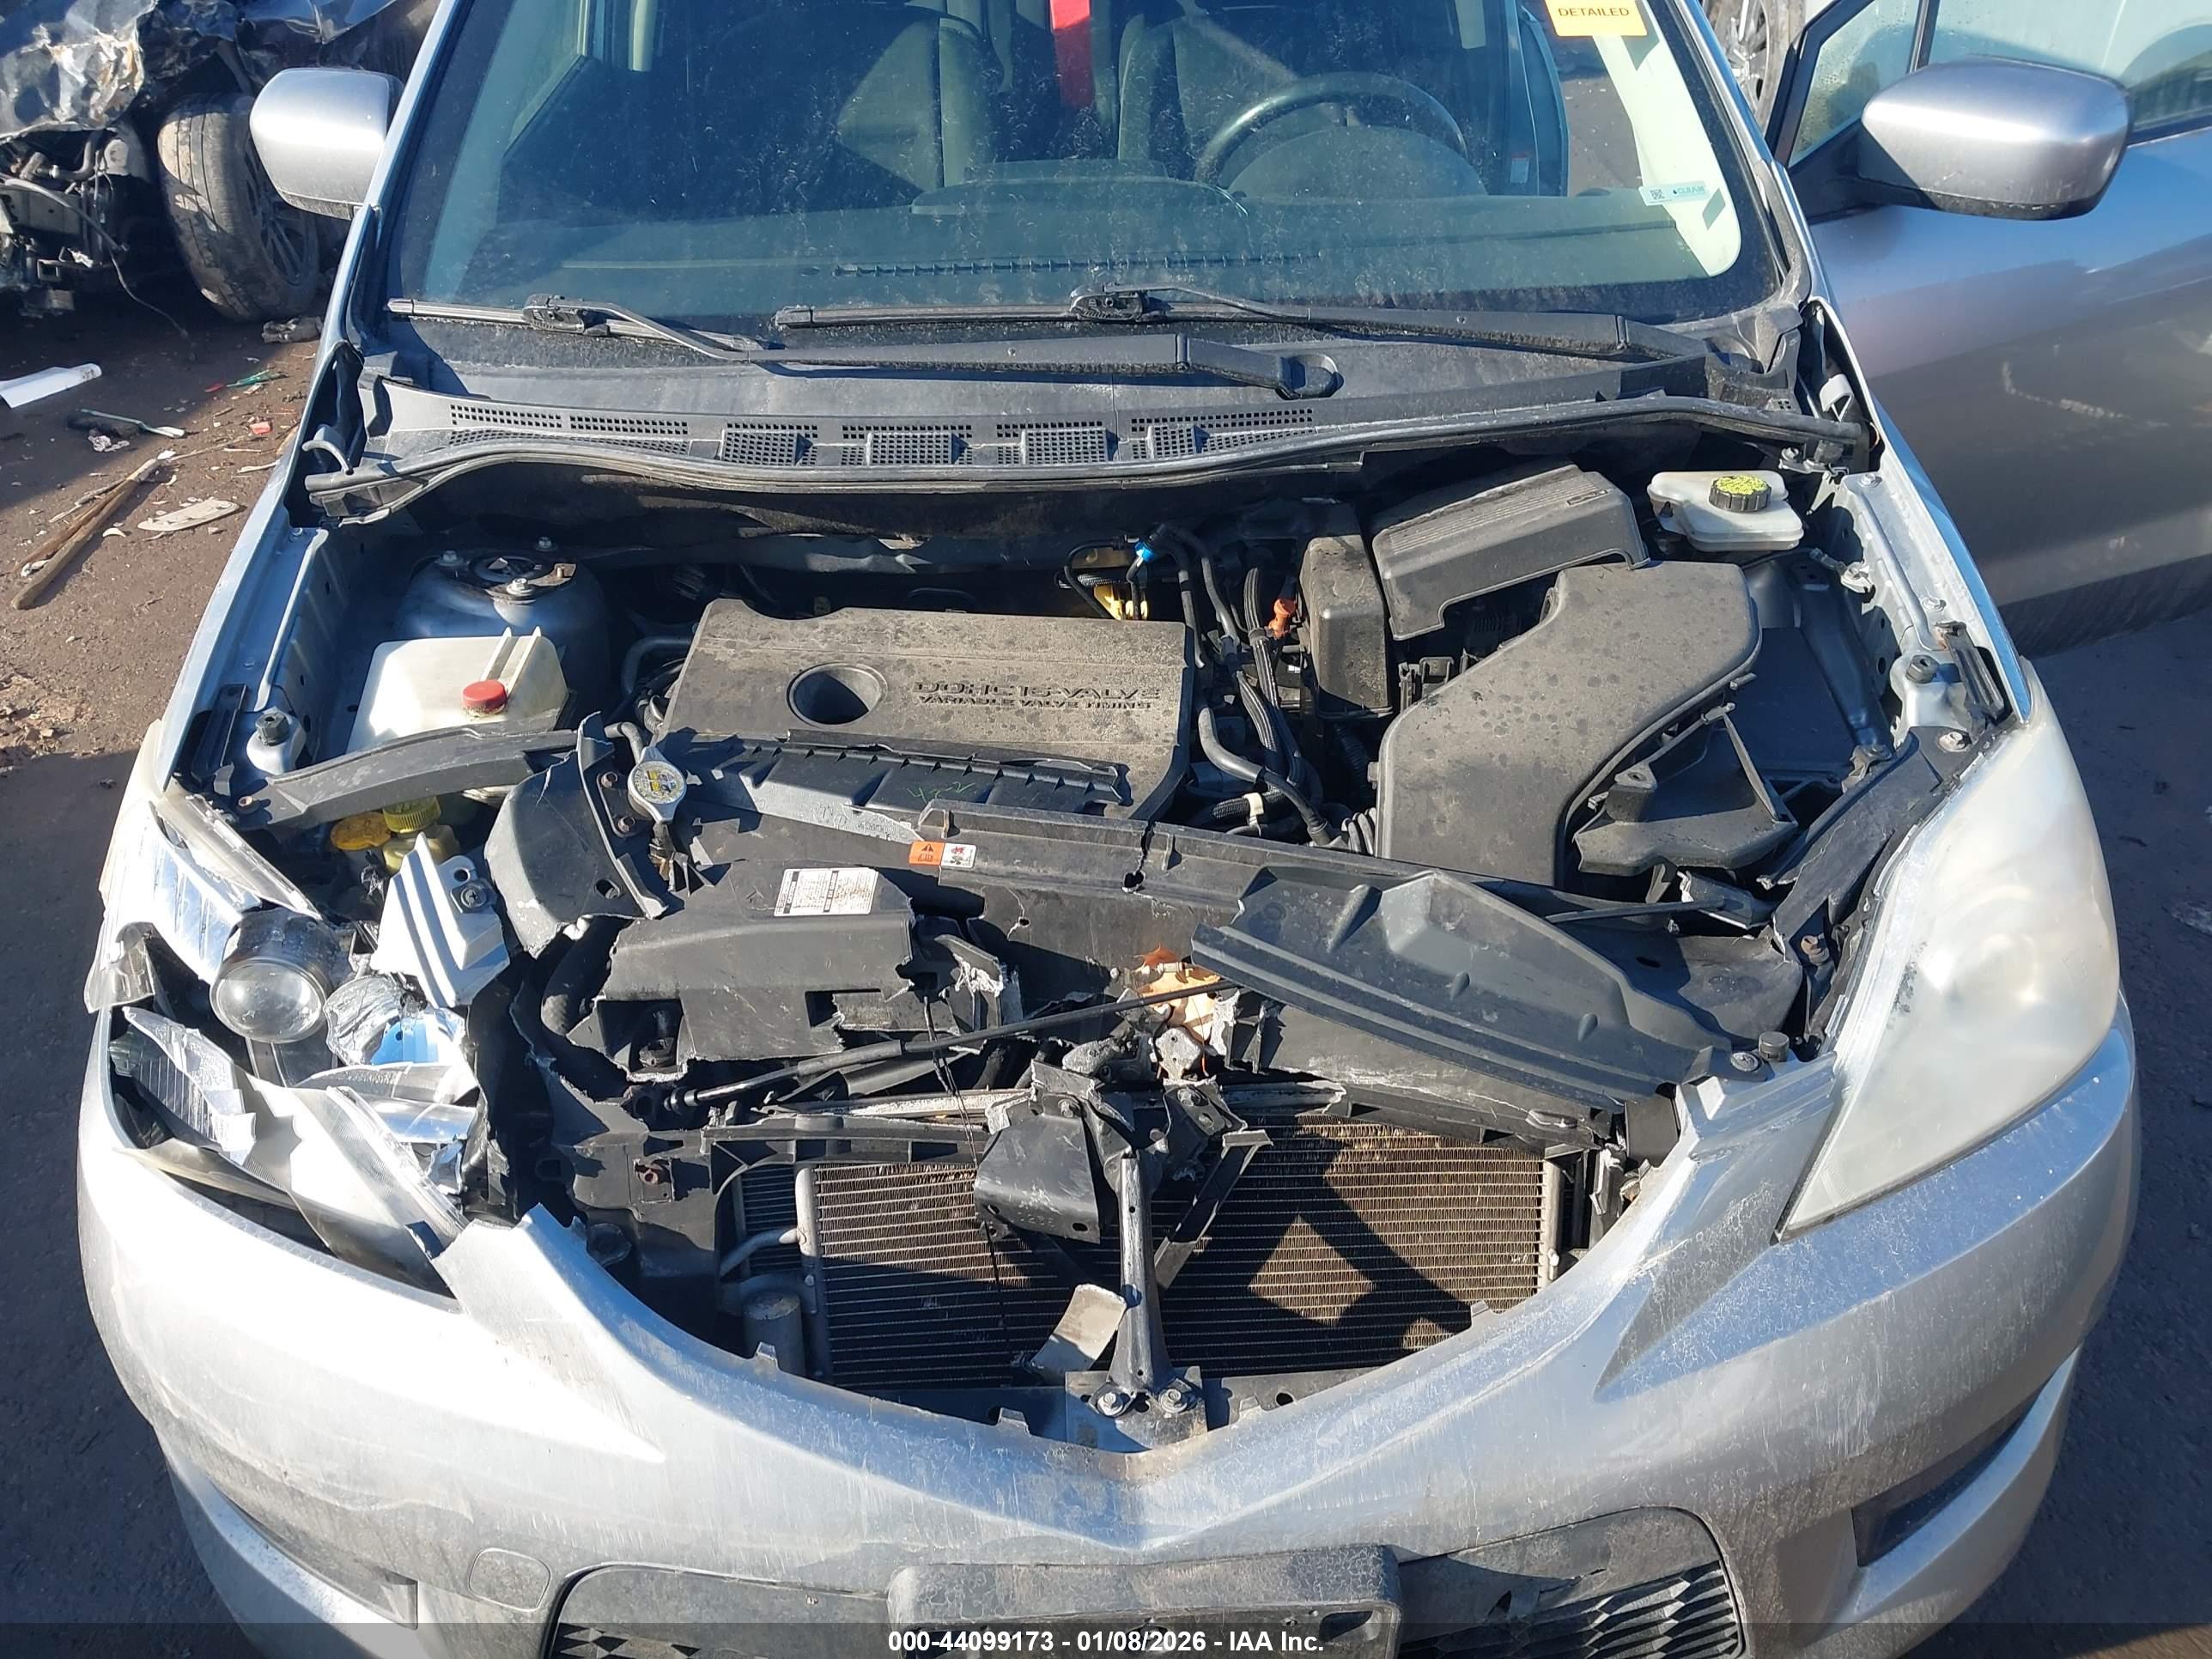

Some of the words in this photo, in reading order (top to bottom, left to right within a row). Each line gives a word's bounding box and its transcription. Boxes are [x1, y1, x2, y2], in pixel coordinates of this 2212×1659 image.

[1558, 7, 1630, 16] DETAILED
[912, 682, 1015, 696] DOHC
[918, 695, 1015, 706] VARIABLE
[1019, 698, 1079, 708] VALVE
